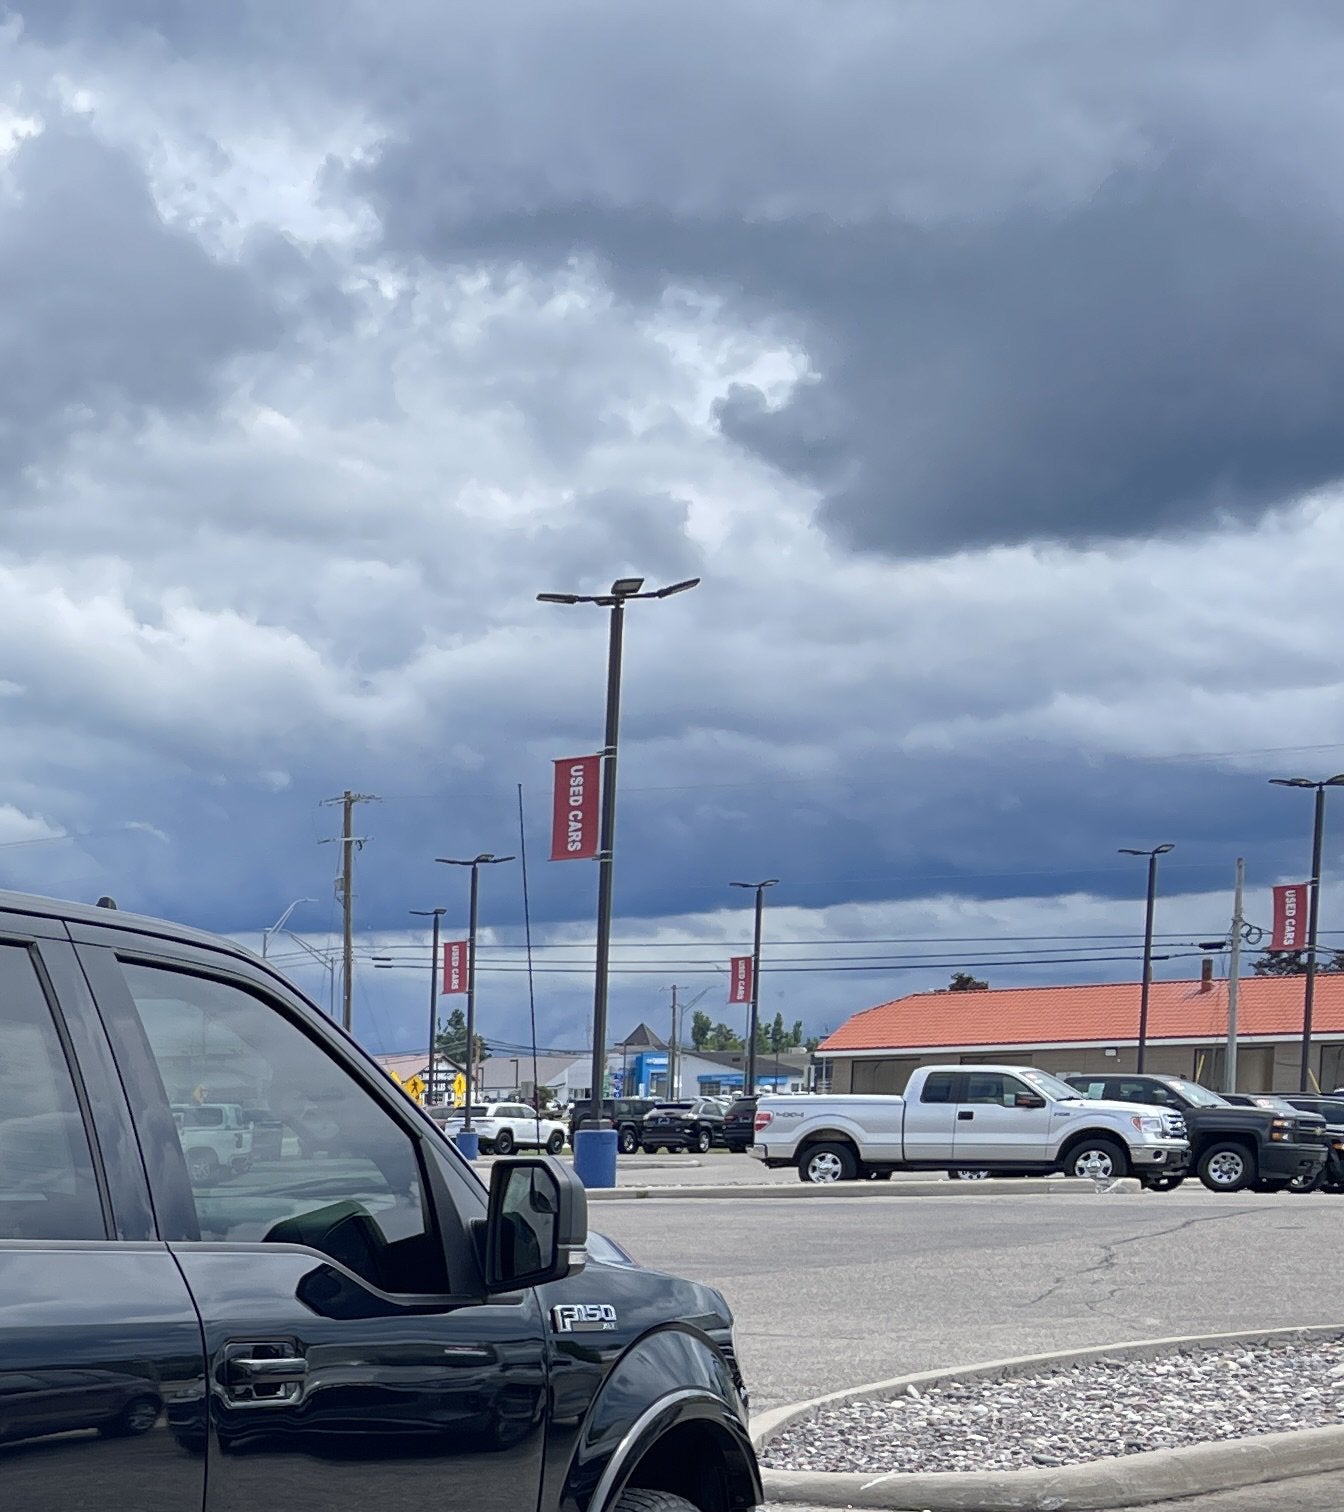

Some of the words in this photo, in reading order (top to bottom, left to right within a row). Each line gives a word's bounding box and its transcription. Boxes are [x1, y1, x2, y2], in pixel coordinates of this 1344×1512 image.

[569, 764, 584, 806] USED
[567, 810, 583, 852] CARS
[1285, 889, 1297, 917] USED
[1283, 918, 1296, 946] CARS
[451, 945, 460, 967] USED
[451, 968, 460, 990] CARS
[738, 959, 746, 980] USED
[736, 980, 745, 1000] CARS
